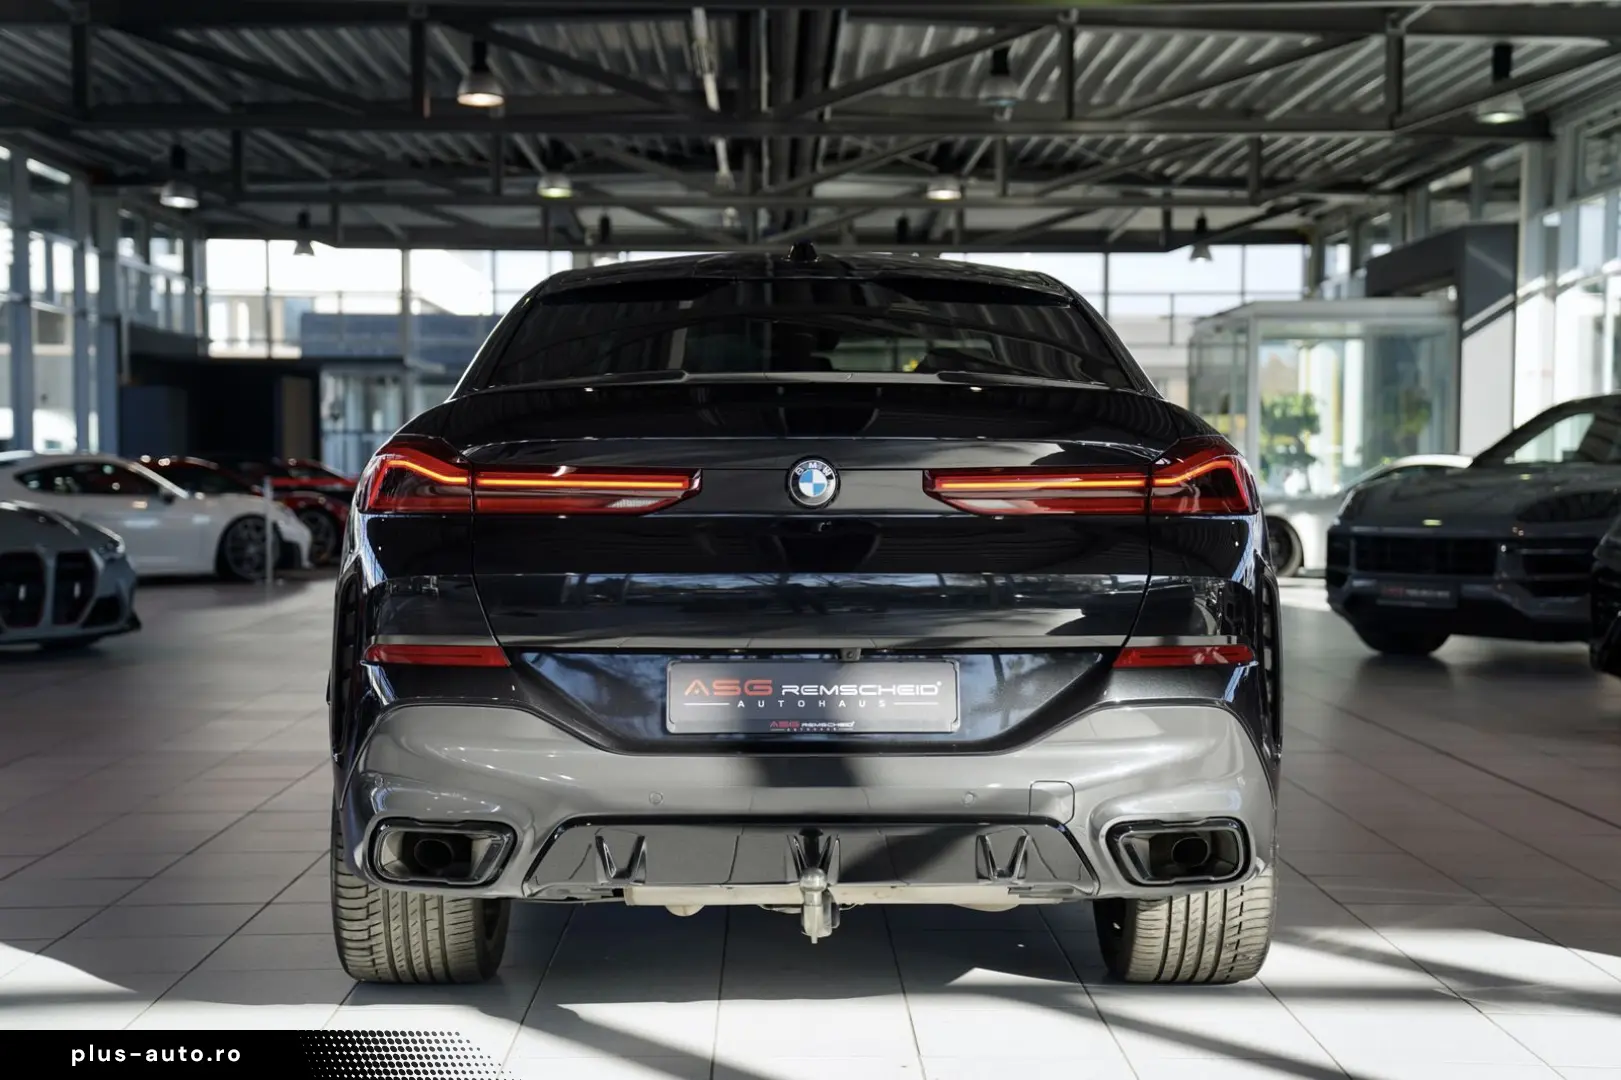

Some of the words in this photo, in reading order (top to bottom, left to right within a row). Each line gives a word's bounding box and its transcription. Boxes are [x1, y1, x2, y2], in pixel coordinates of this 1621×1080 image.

[794, 462, 832, 476] BMW
[684, 679, 773, 696] ASG
[737, 699, 887, 708] AUTOHAUS
